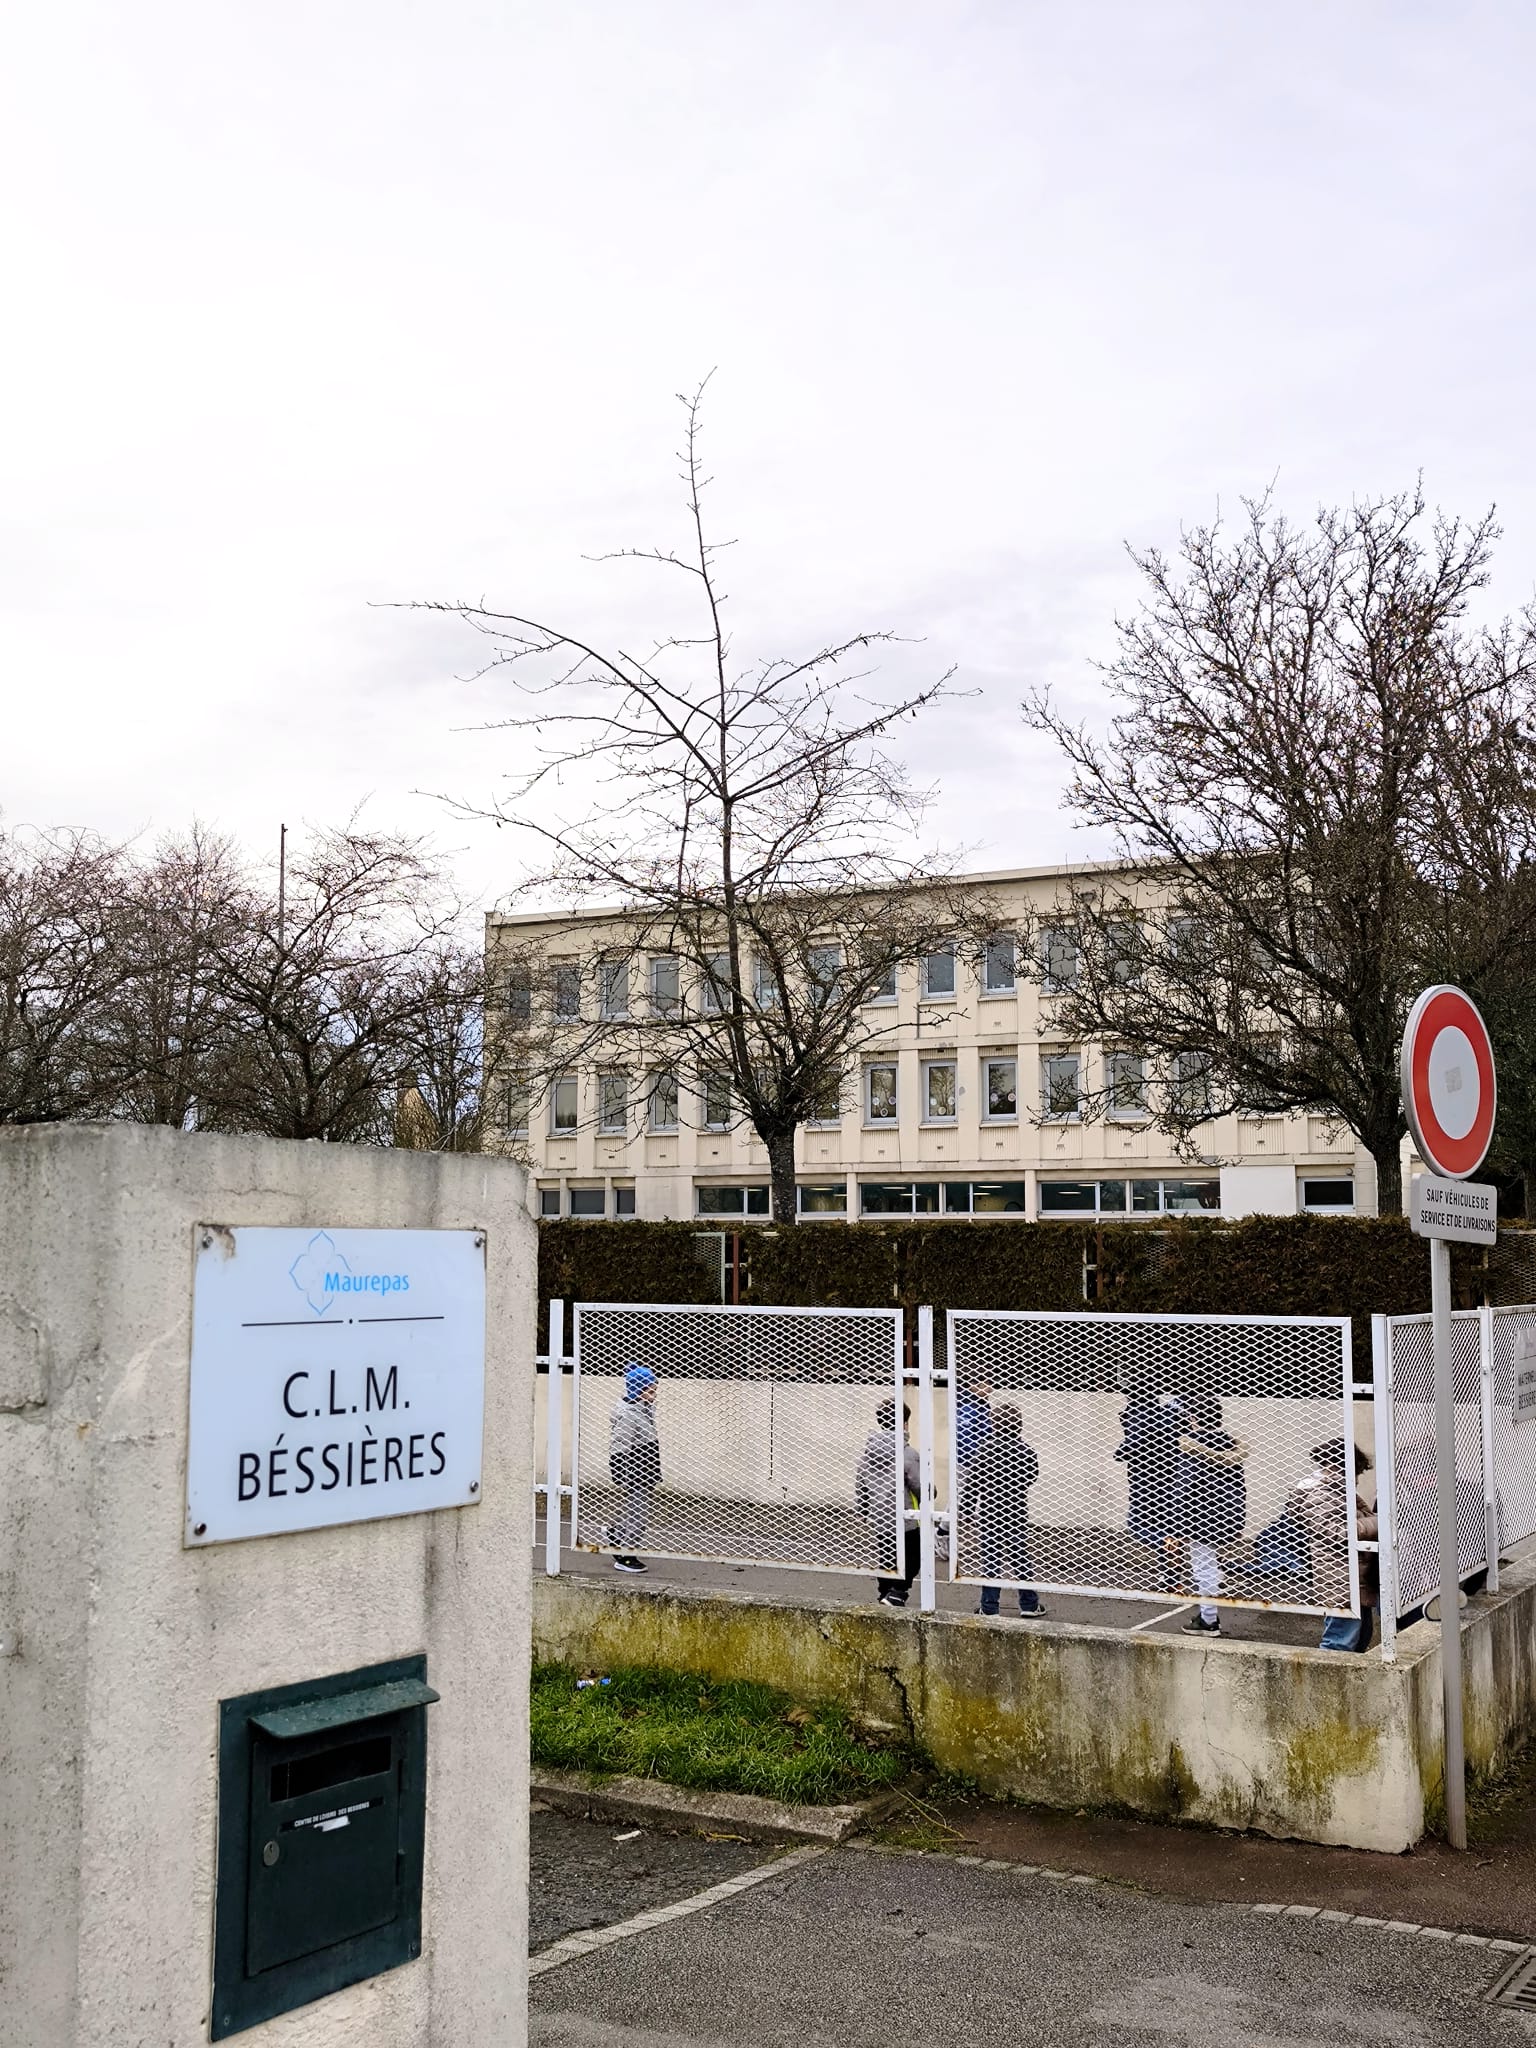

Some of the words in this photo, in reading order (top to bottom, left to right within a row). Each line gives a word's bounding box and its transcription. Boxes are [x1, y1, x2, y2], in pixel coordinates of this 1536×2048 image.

[1426, 1188, 1443, 1203] SAUF
[1445, 1189, 1479, 1208] VÉHICULES
[1480, 1197, 1489, 1210] DE
[1421, 1209, 1445, 1226] SERVICE
[1446, 1213, 1454, 1227] ET
[1454, 1215, 1462, 1228] DE
[1463, 1216, 1496, 1233] LIVRAISONS
[324, 1272, 410, 1296] Maurepas
[283, 1365, 411, 1419] C.L.M.
[237, 1425, 447, 1502] BÉSSIÈRES
